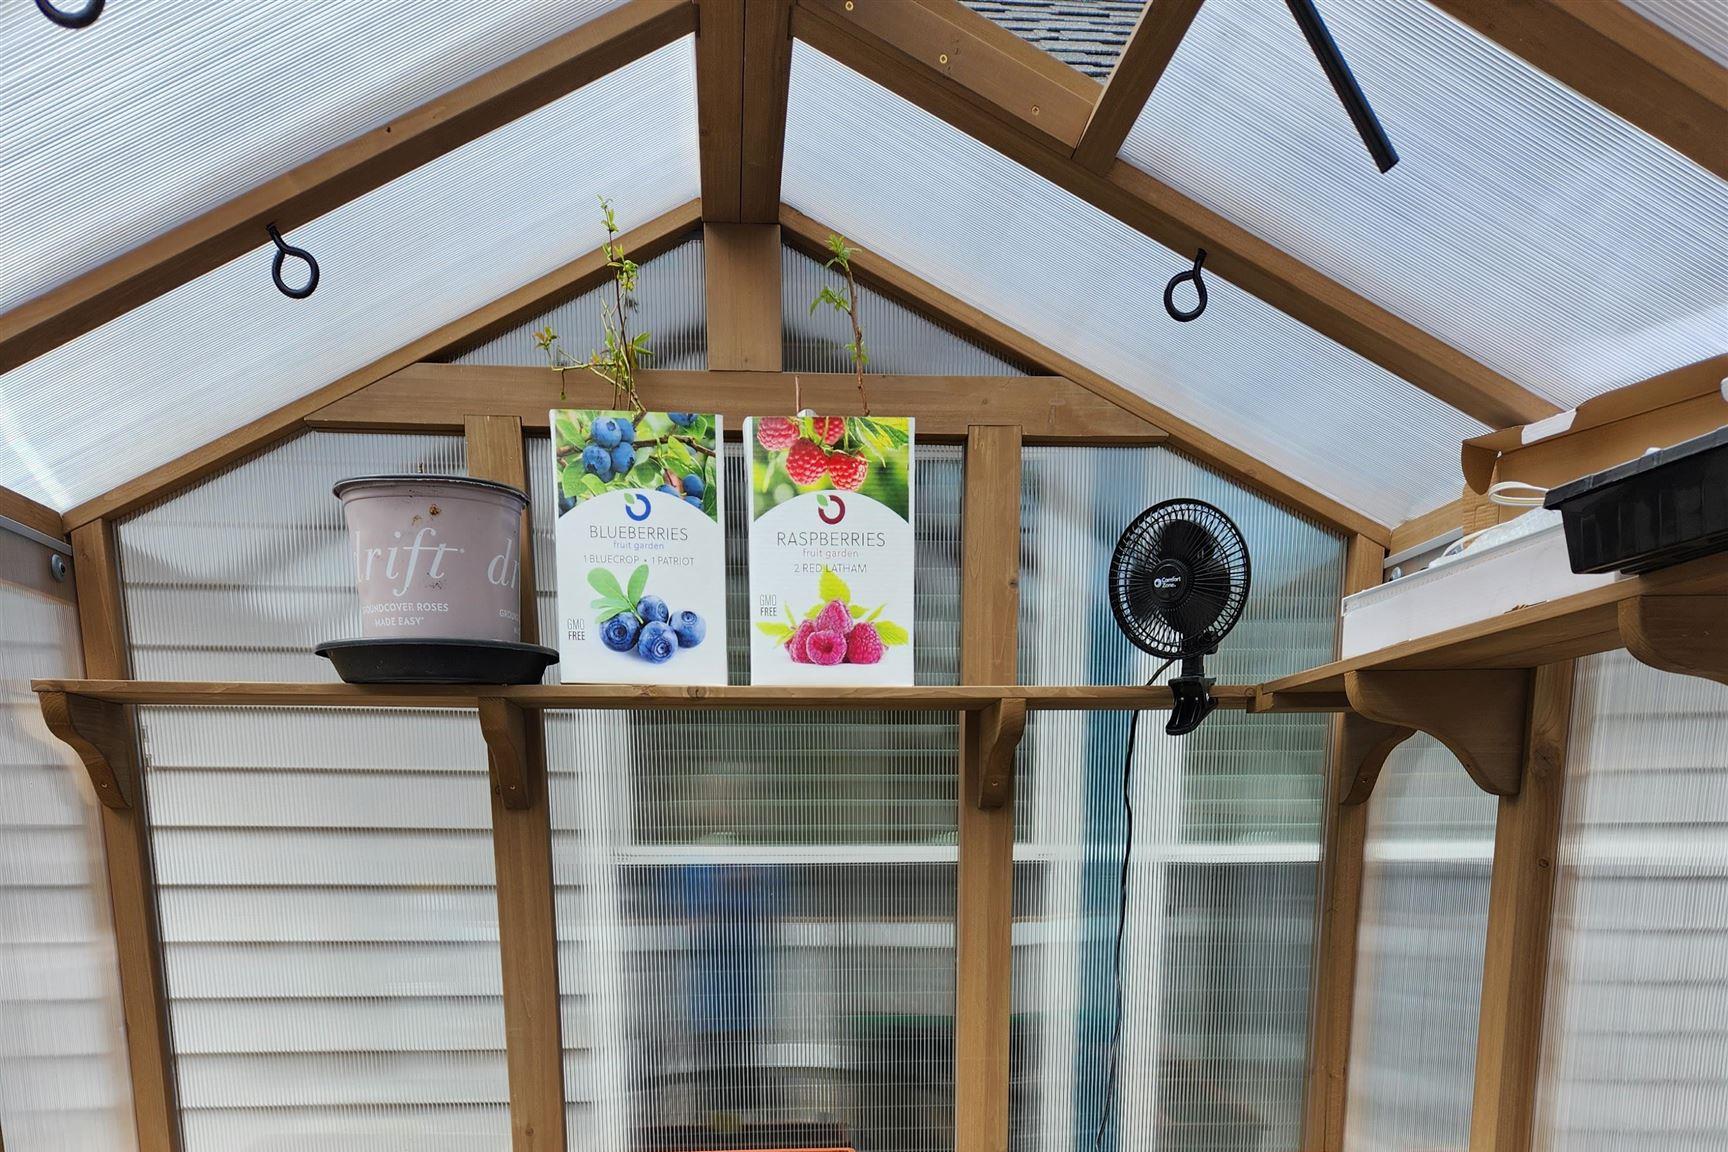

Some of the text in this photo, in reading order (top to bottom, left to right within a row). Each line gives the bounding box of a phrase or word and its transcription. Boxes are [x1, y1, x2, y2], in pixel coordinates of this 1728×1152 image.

[590, 525, 688, 541] BLUEBERRIES
[777, 531, 886, 547] RASPBERRIES
[613, 541, 664, 551] fruit garden
[803, 549, 859, 559] fruit garden
[589, 555, 640, 564] BLUECROP
[657, 557, 695, 566] PATRIOT
[794, 563, 867, 573] 2 RED LATHAM
[760, 595, 777, 606] GMO
[417, 602, 449, 613] ROSES
[760, 607, 777, 617] FREE
[568, 631, 585, 641] FREE
